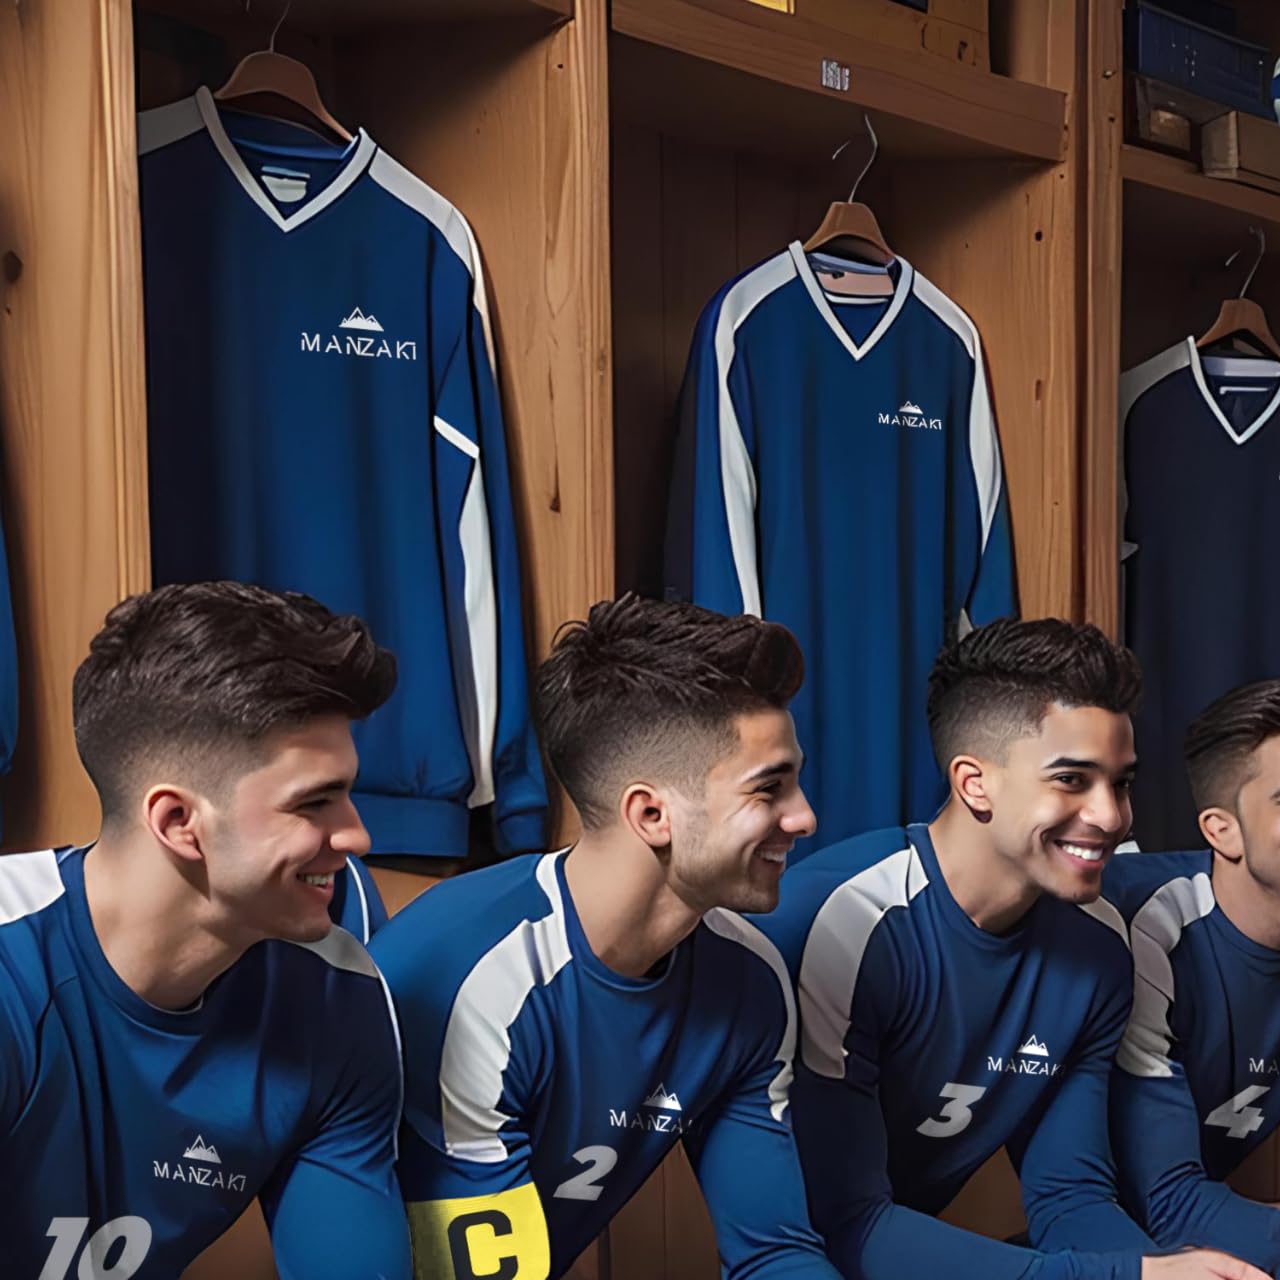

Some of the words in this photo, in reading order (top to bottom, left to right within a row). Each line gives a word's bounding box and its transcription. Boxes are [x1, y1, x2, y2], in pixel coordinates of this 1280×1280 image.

[301, 332, 417, 361] MANZAKI
[878, 412, 942, 430] MANZAKI
[609, 1108, 695, 1134] MANZA
[916, 1082, 987, 1139] 3
[1203, 1084, 1271, 1140] 4
[153, 1160, 247, 1193] MANZAKI
[552, 1145, 618, 1201] 2
